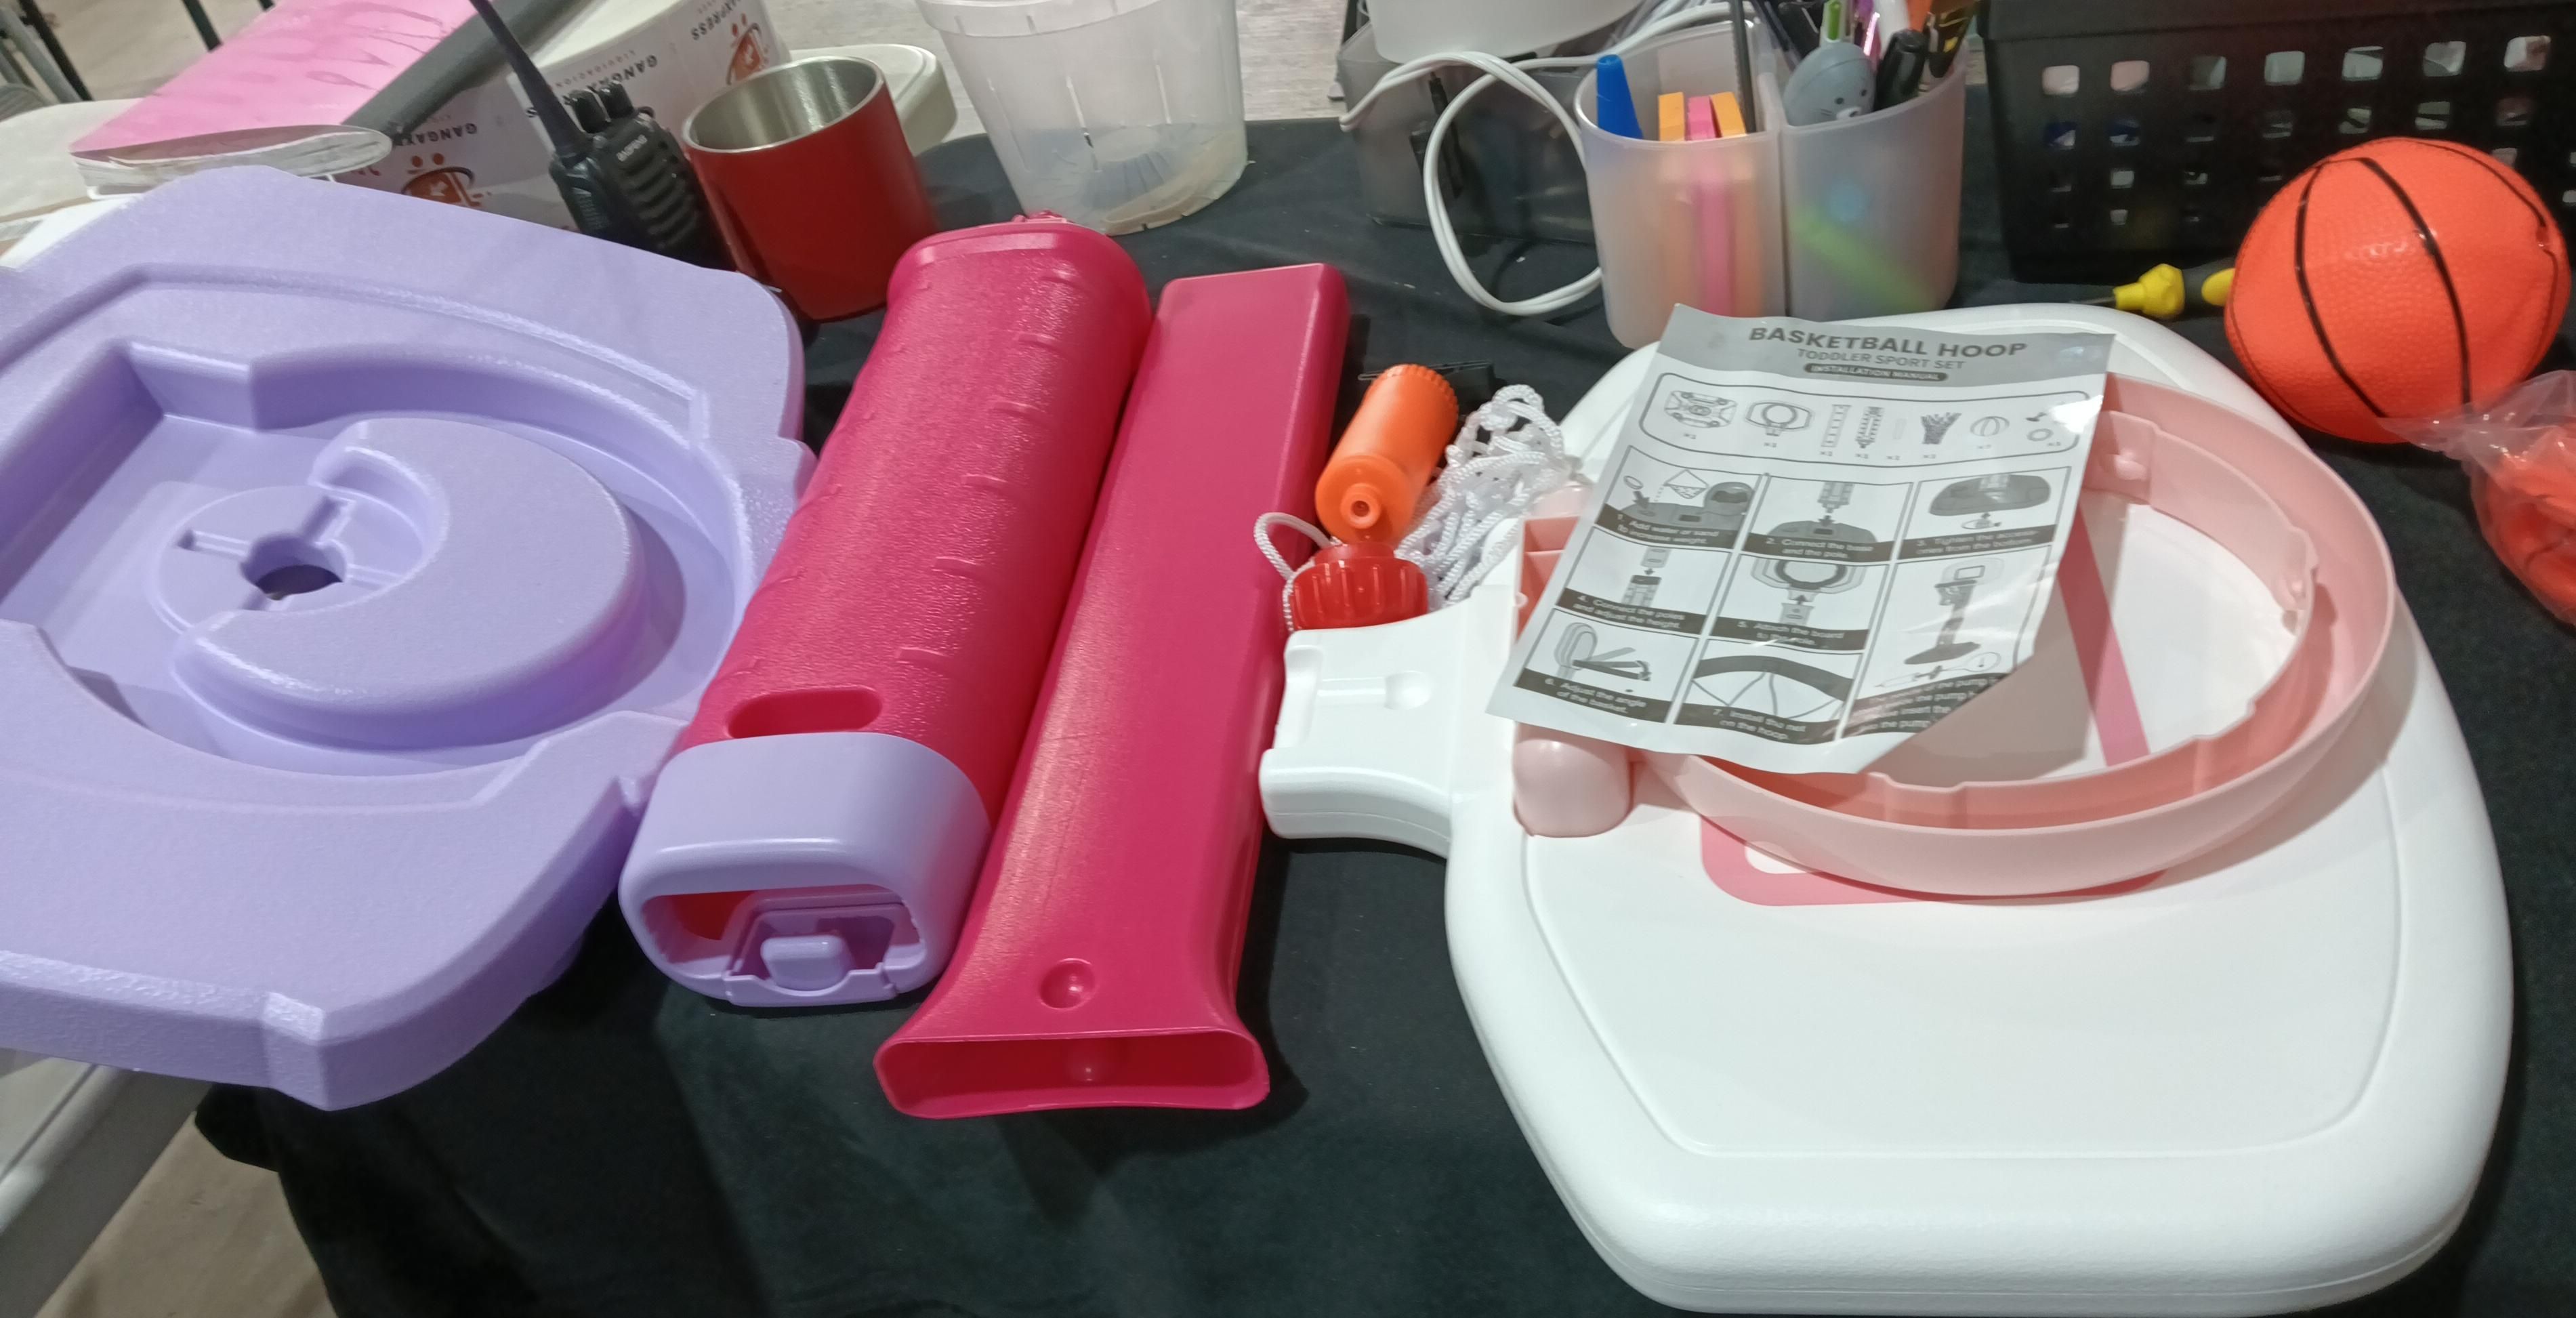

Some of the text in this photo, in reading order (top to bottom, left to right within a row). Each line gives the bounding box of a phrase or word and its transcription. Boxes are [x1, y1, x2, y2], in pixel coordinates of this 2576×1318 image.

[1749, 327, 2027, 358] BASKETBALL HOOP
[1797, 348, 1966, 370] TODDLER SPORT SET
[1811, 365, 1939, 380] INSTALLATION MANUAL
[1629, 521, 1650, 531] Add
[1781, 539, 1825, 548] Connect
[1573, 603, 1594, 613] and
[1594, 609, 1626, 621] adjust
[1627, 615, 1645, 623] the
[1593, 598, 1637, 613] Connect
[1637, 608, 1655, 616] the
[1655, 611, 1686, 621] poles
[1753, 623, 1789, 632] Attach
[1791, 627, 1810, 635] the
[1810, 630, 1845, 639] board
[1955, 678, 1988, 688] pump
[1560, 682, 1596, 696] Adjust
[1596, 691, 1614, 701] the
[1615, 697, 1647, 708] angle
[1569, 693, 1588, 703] the
[1934, 692, 1967, 701] pump
[1730, 711, 1765, 723] Install
[1765, 718, 1785, 728] the
[1785, 724, 1806, 732] net
[1737, 722, 1757, 732] the
[1757, 726, 1789, 741] hoop.
